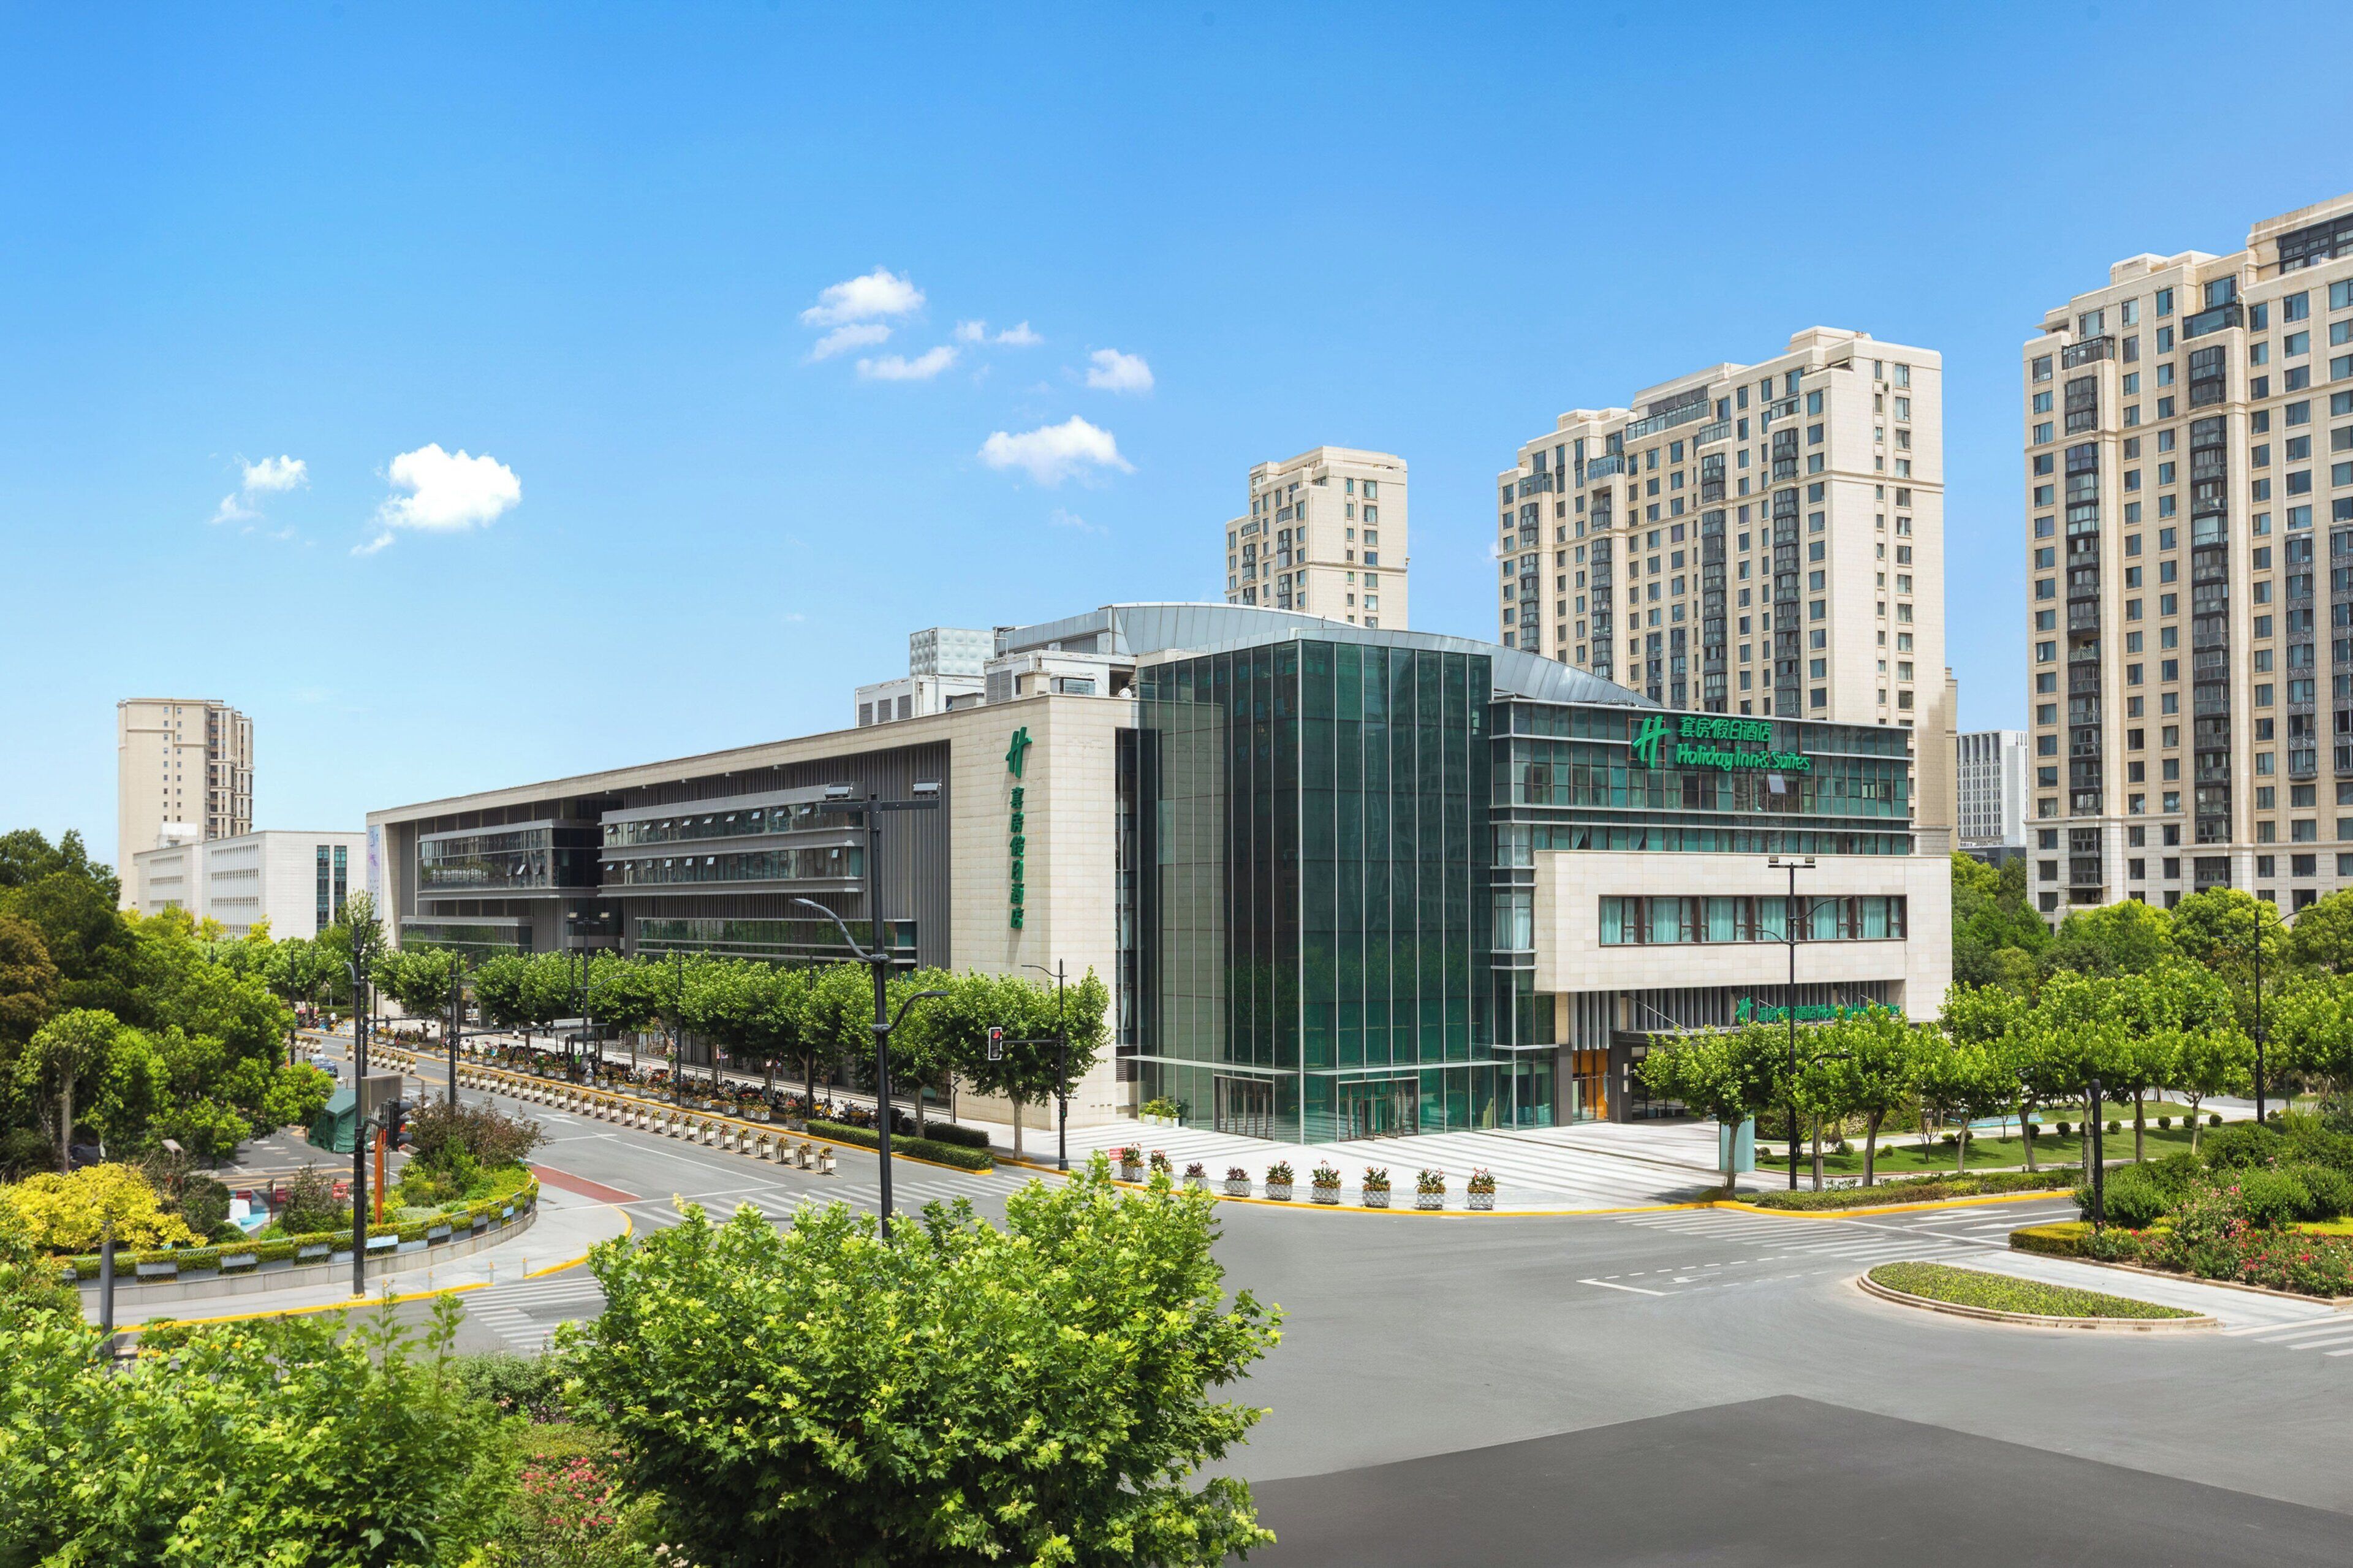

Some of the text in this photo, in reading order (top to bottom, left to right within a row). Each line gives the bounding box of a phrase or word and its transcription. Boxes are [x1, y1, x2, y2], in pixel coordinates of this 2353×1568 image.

[1678, 716, 1773, 743] 套房假日酒店
[1675, 743, 1811, 771] Holiday Inn & Suites
[1010, 787, 1025, 929] 套房假日酒店
